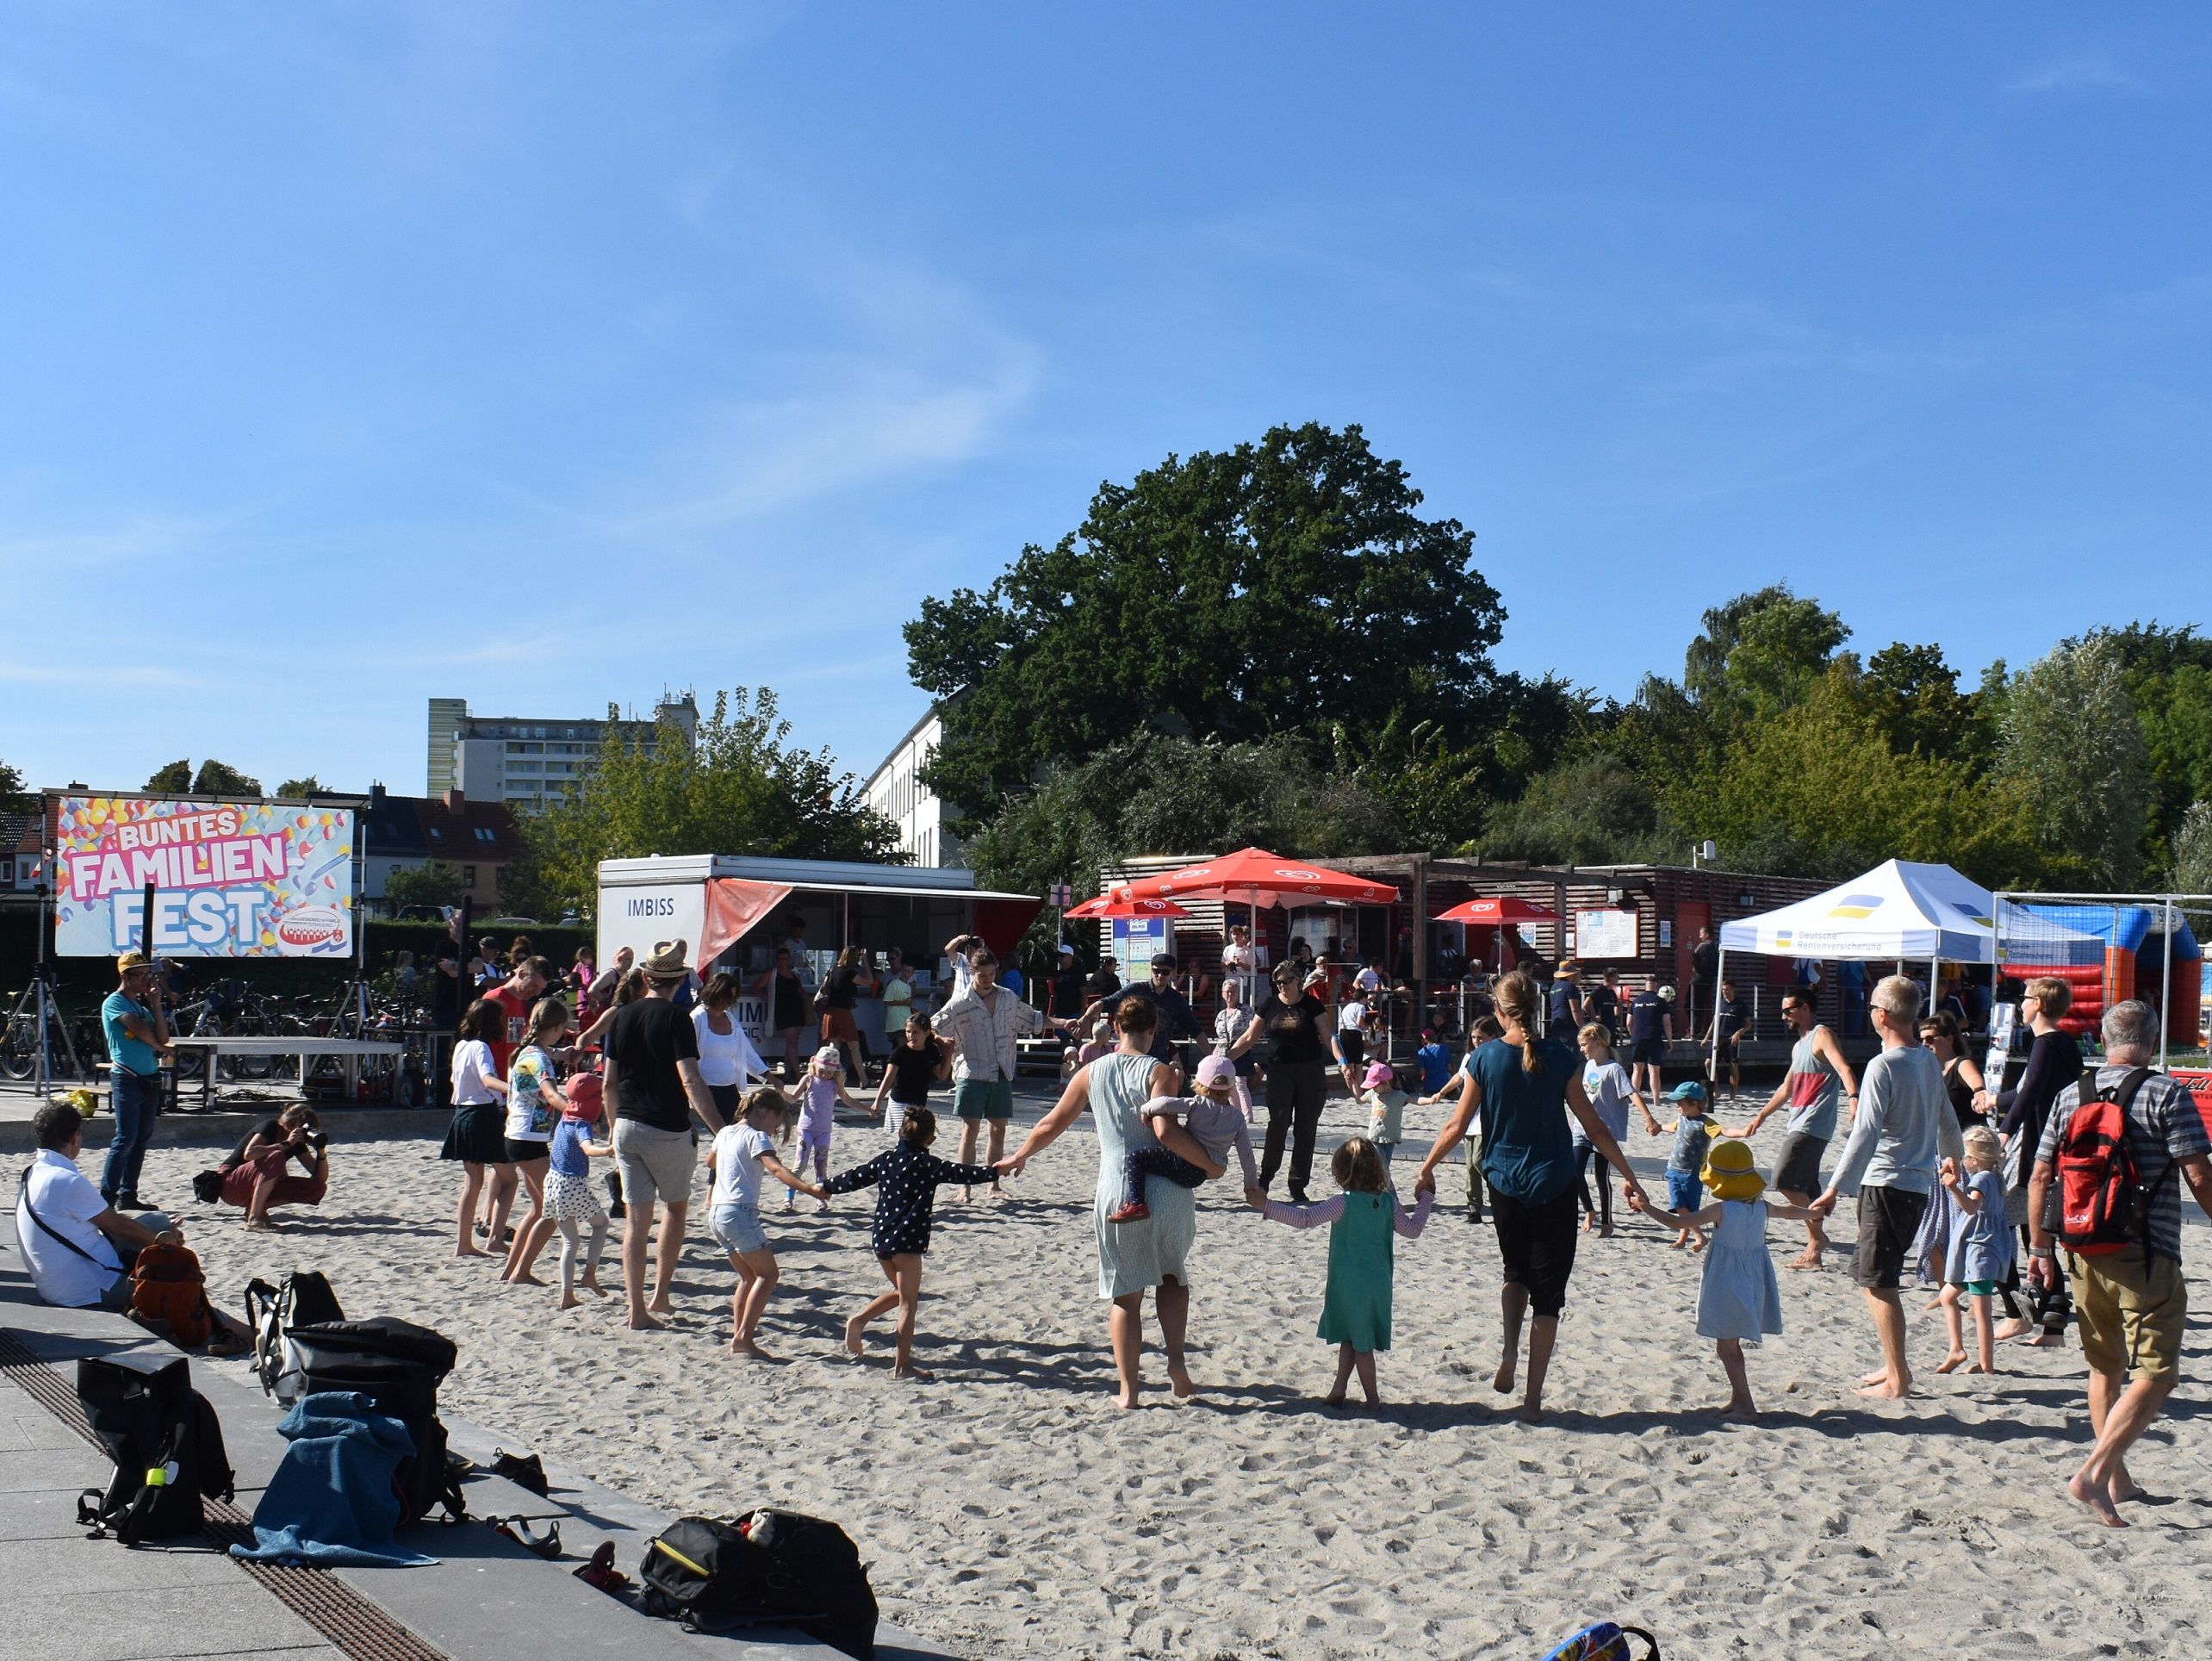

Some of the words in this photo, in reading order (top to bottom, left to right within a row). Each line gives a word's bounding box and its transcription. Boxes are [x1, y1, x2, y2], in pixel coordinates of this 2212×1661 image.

[119, 812, 237, 850] BUNTES
[71, 837, 285, 898] FAMILIEN
[114, 891, 265, 947] FEST
[628, 898, 674, 917] IMBISS
[1798, 941, 1881, 951] Rentenversicherung
[1799, 930, 1837, 939] Deutsche
